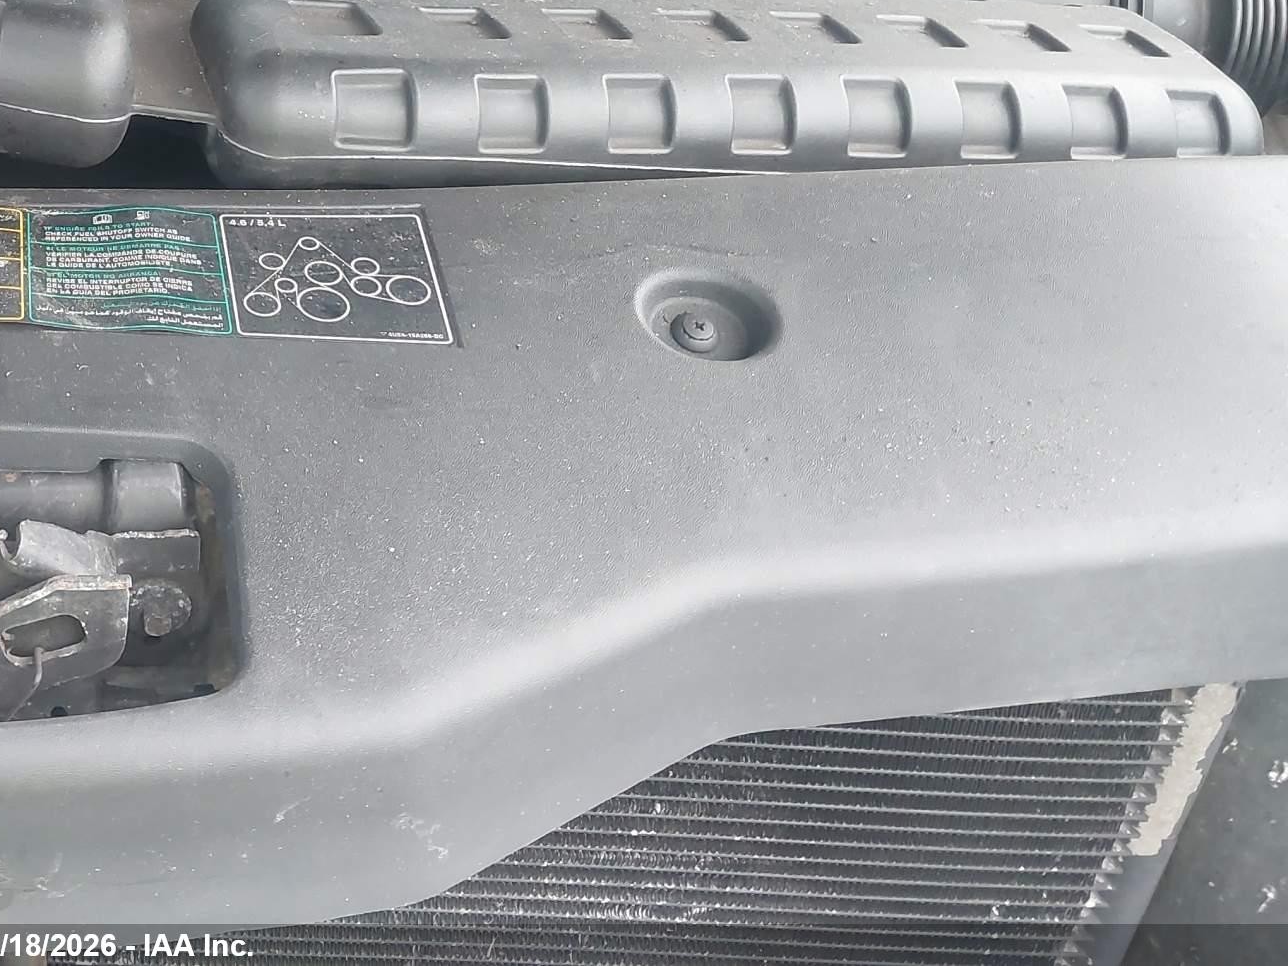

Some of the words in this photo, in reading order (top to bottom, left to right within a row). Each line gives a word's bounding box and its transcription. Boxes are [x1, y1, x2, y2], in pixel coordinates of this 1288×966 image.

[229, 218, 247, 227] 4.6
[256, 218, 274, 227] 5.4
[277, 219, 287, 227] L
[96, 228, 133, 236] SHUTOFF
[135, 226, 166, 234] SWITCH
[110, 233, 133, 241] YOUR
[69, 244, 105, 252] MOTEUR
[164, 243, 180, 251] PAS
[96, 249, 144, 258] COMMANDE
[159, 249, 199, 260] COUPURE
[112, 254, 143, 263] COMME
[179, 257, 202, 266] DANS
[90, 276, 148, 285] INTERRUPTOR
[162, 277, 193, 286] CIERRE
[165, 283, 193, 292] INDICA
